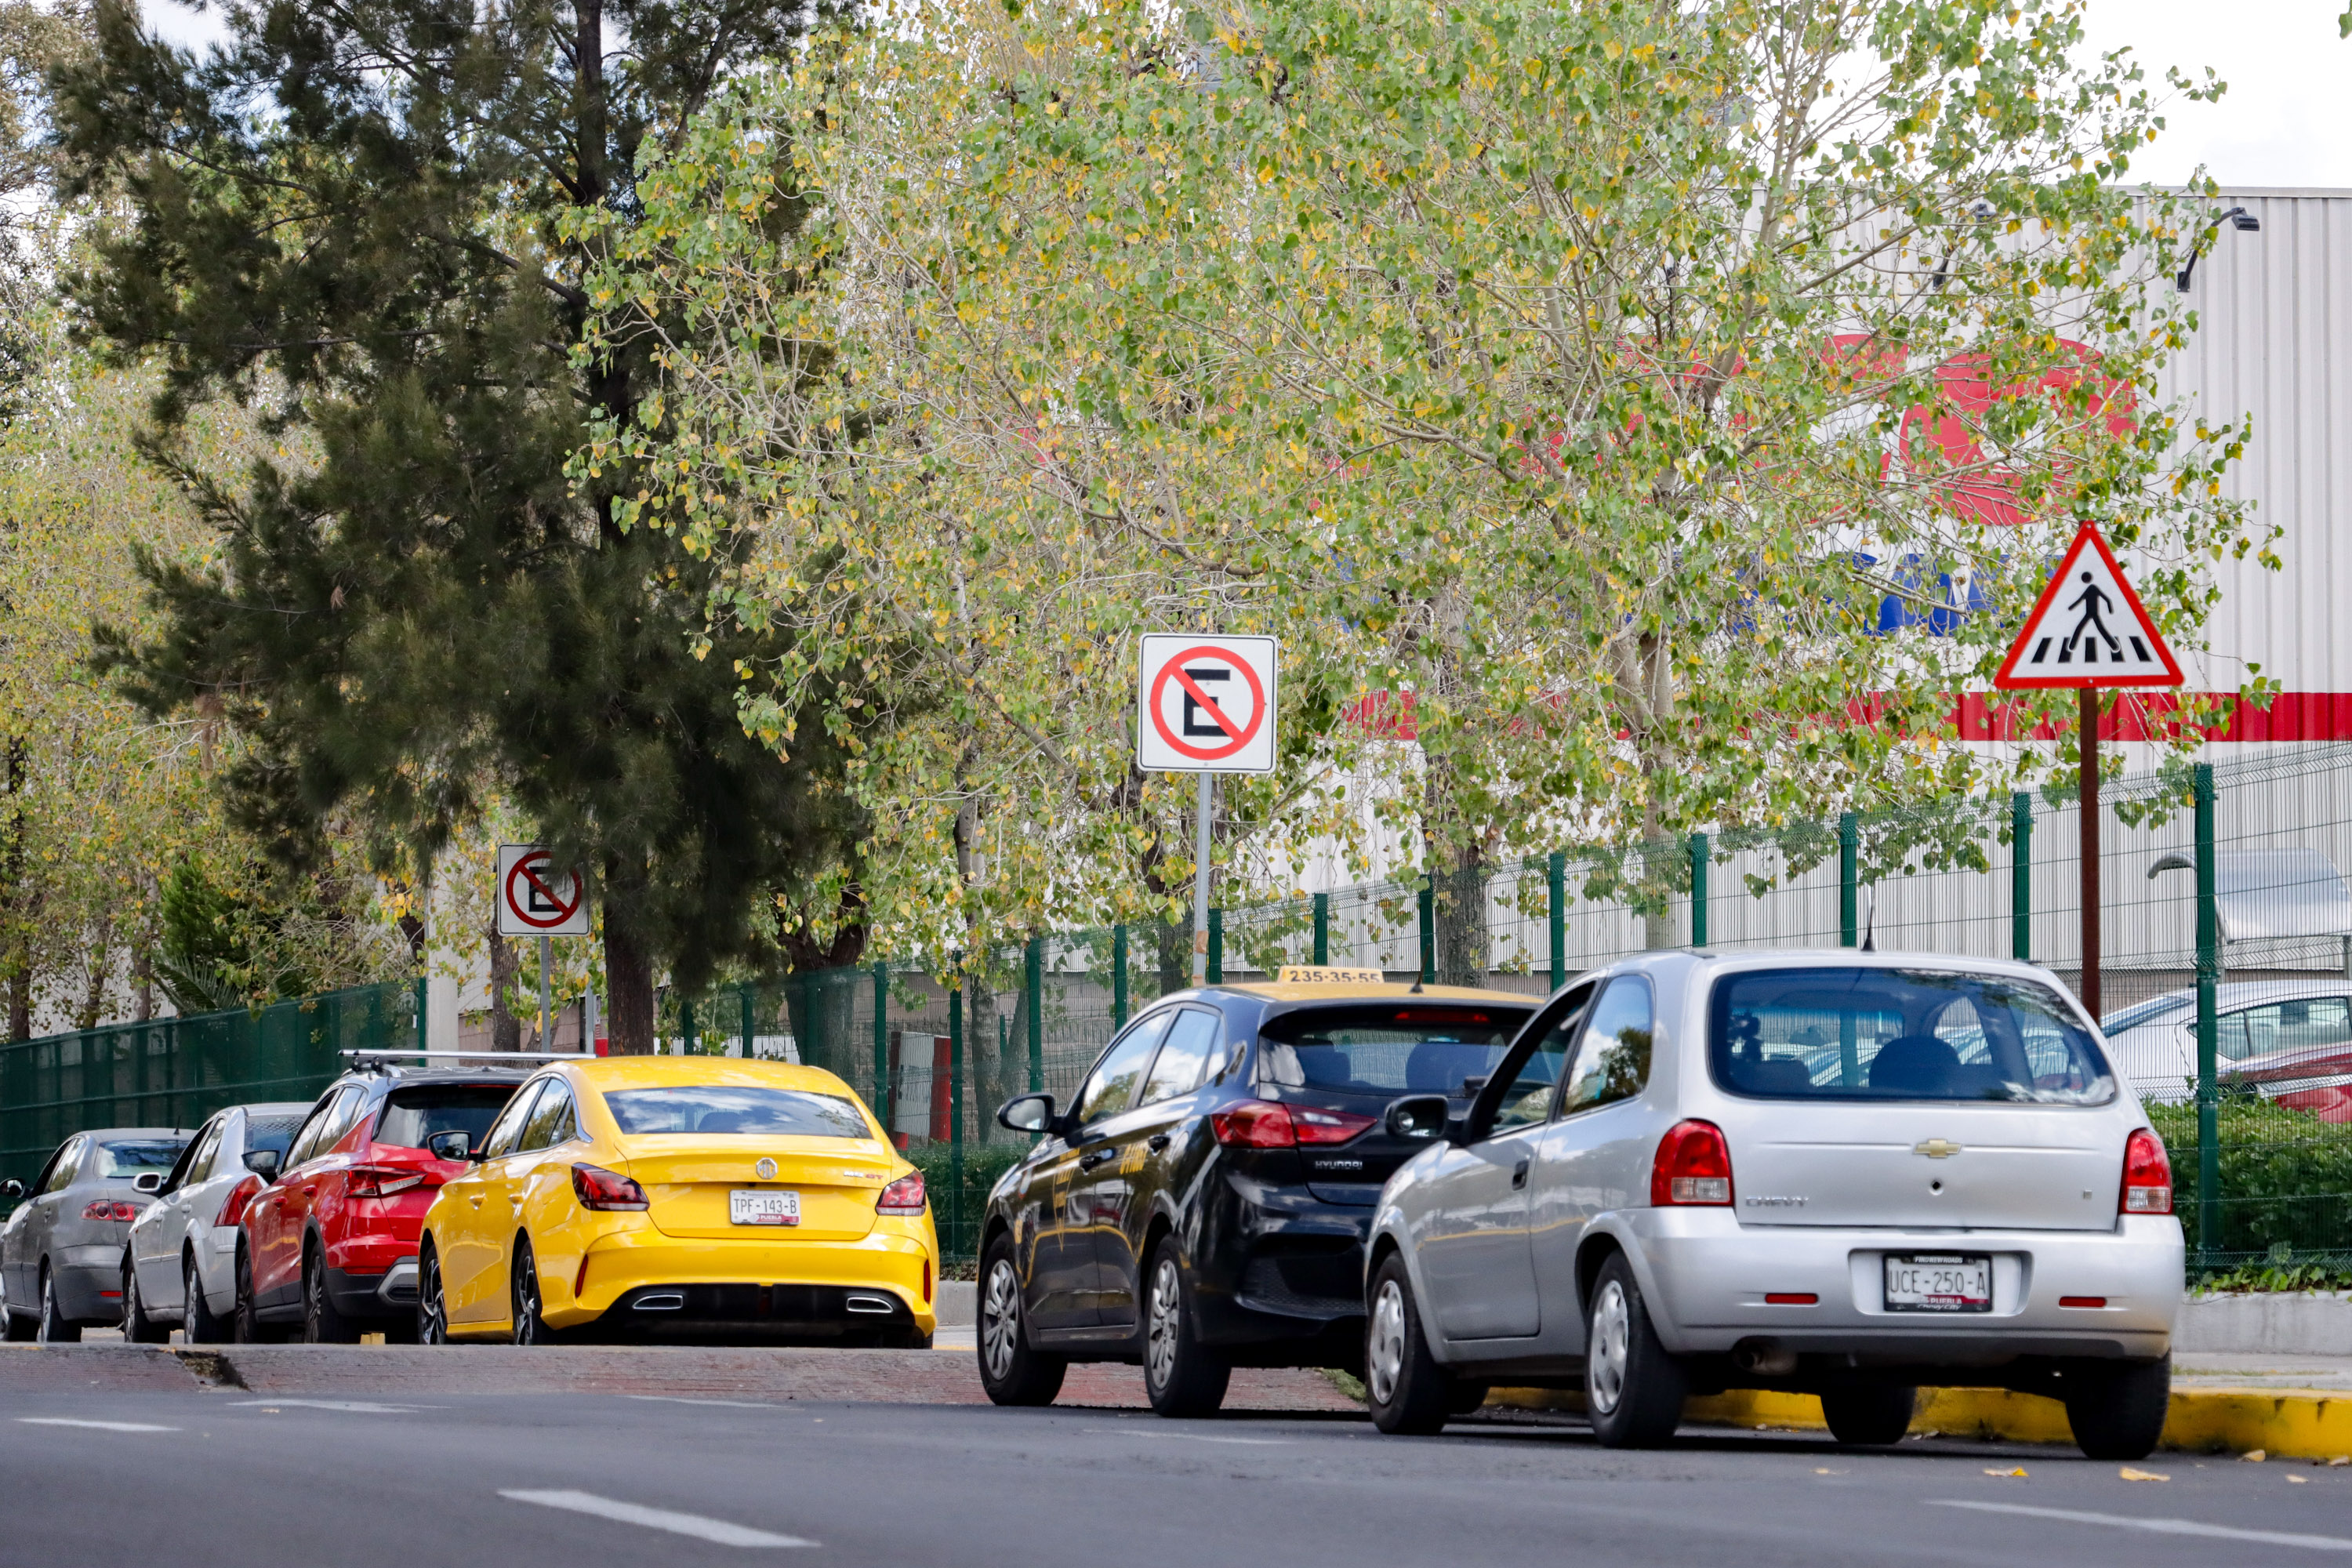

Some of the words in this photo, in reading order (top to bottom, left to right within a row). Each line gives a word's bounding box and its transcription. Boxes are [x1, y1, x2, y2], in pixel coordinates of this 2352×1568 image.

[1316, 1161, 1363, 1170] HYUNDAI
[734, 1198, 797, 1214] TPF-143-B
[1745, 1196, 1809, 1207] CHEVY
[1889, 1270, 1986, 1294] UCE-250-A
